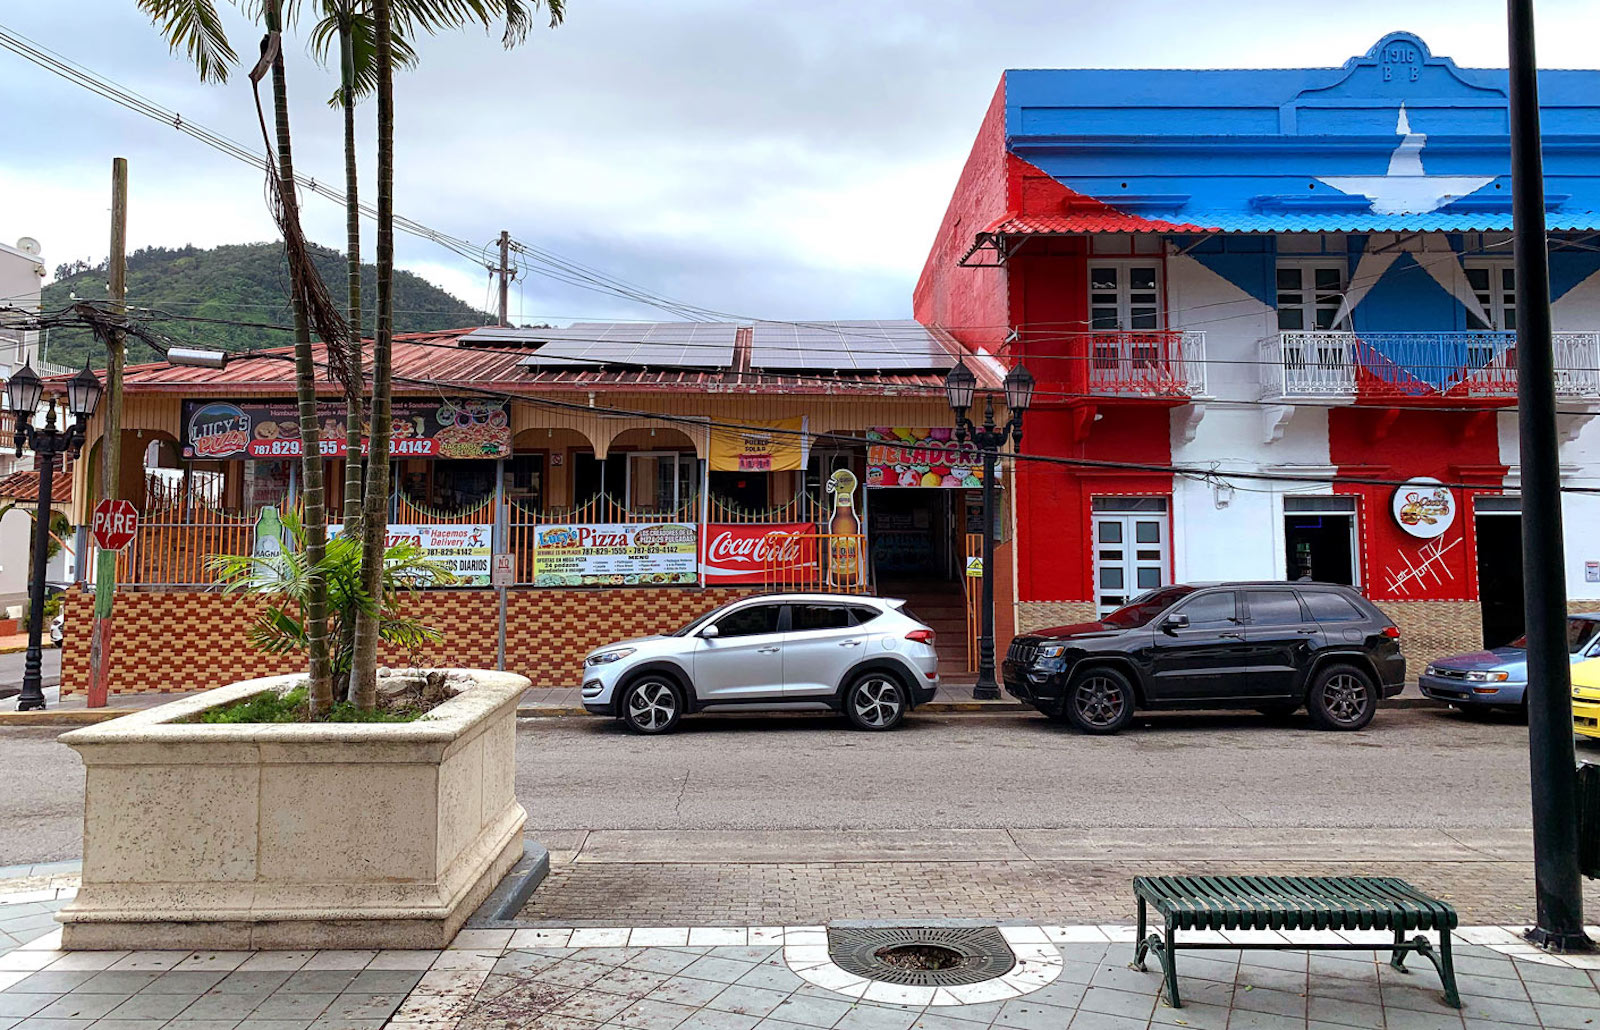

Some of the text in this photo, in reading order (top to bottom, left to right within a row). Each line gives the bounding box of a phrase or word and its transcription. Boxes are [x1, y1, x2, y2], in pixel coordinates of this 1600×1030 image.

[1383, 48, 1414, 64] 1916
[1383, 66, 1418, 82] B B
[192, 416, 248, 441] LUCY'S
[254, 441, 337, 455] 787.829.55
[95, 511, 136, 534] PARE
[384, 529, 422, 548] izza
[430, 529, 468, 538] Hacemos
[537, 526, 629, 547] Lucy's Pizza
[430, 538, 464, 547] Delivery
[708, 531, 799, 562] Coca-Cola
[428, 548, 473, 556] 787-829-4142
[583, 547, 627, 555] 787-829-1555
[634, 546, 678, 554] 787-829-4142
[459, 559, 487, 571] DIARIOS
[498, 558, 509, 566] NO
